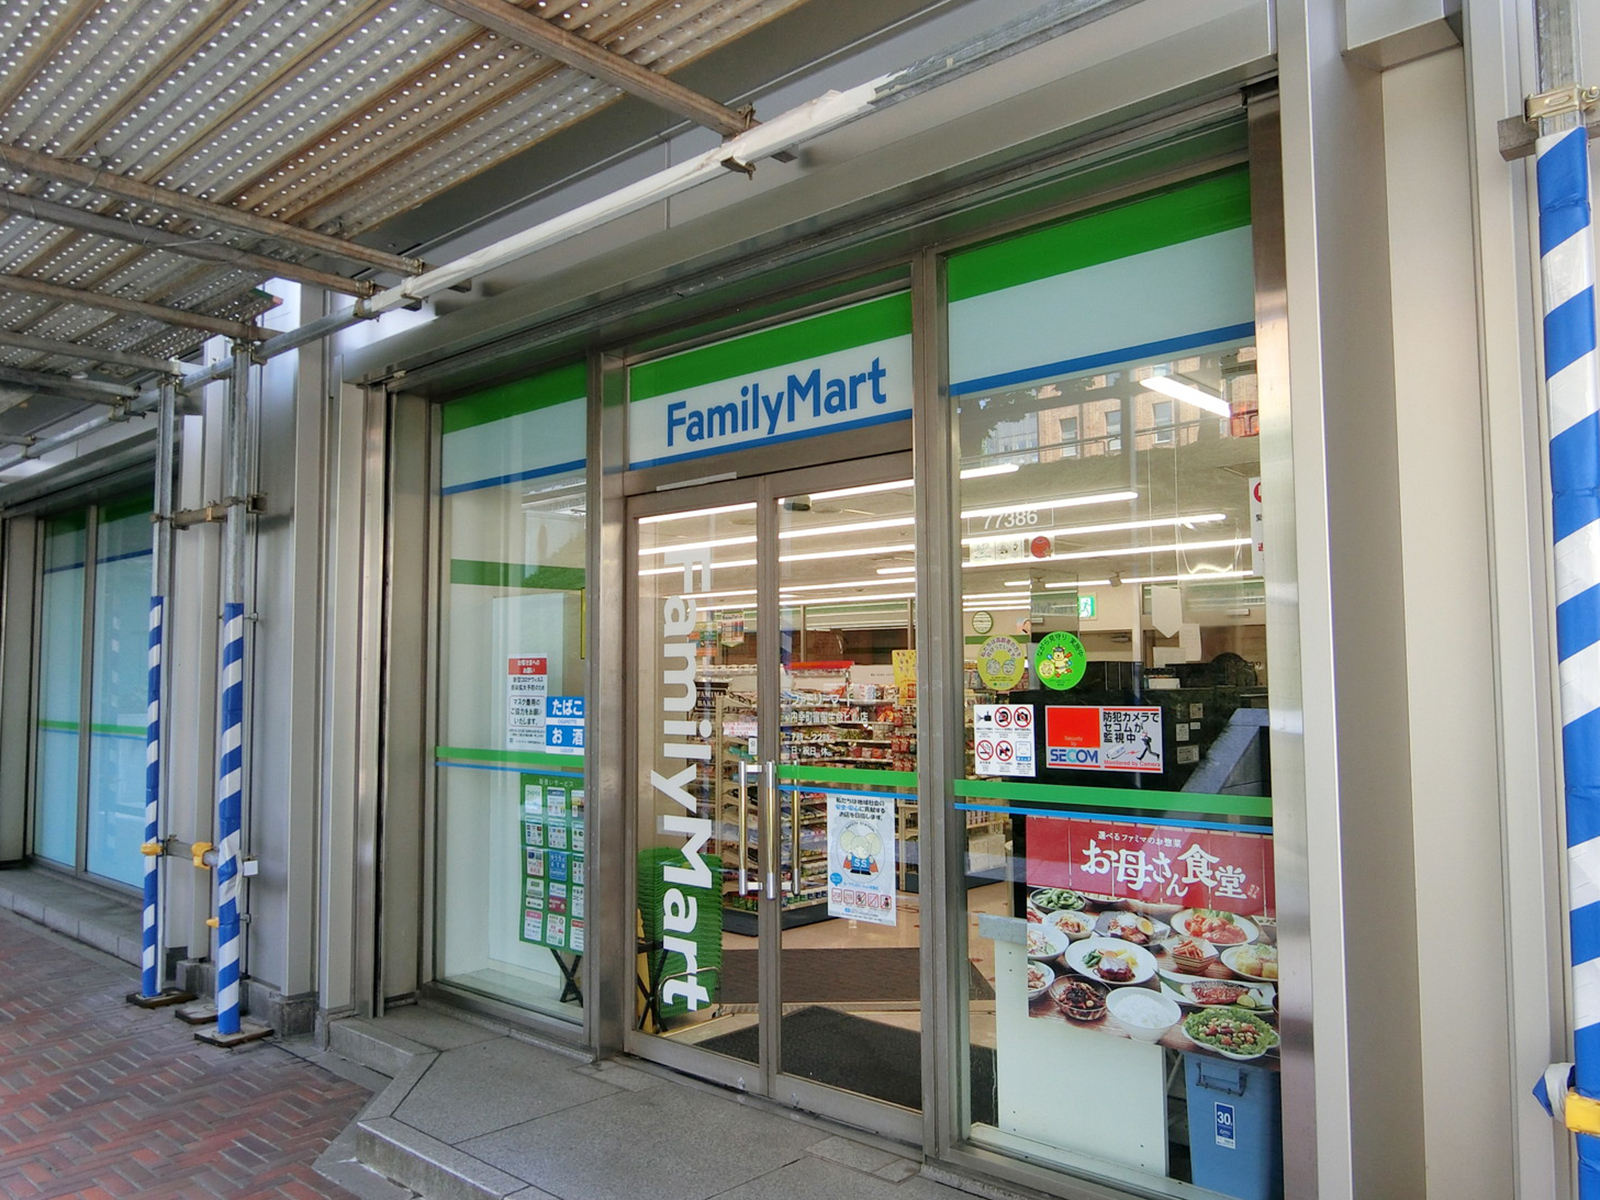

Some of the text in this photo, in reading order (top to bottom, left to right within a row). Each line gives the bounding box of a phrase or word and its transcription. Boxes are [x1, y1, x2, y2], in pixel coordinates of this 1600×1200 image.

[667, 357, 887, 447] FamilyMart
[983, 509, 1038, 530] 77386
[552, 698, 583, 716] たばこ
[1103, 711, 1160, 723] 防犯カメラで
[1103, 721, 1144, 733] セコムが
[1103, 732, 1136, 744] 監視中
[1050, 749, 1099, 764] SECOM
[651, 547, 712, 1012] FamilyMart
[1097, 830, 1182, 849] 選べるファミマのお惣菜
[854, 859, 868, 868] SS
[1080, 839, 1248, 900] お母さん食堂
